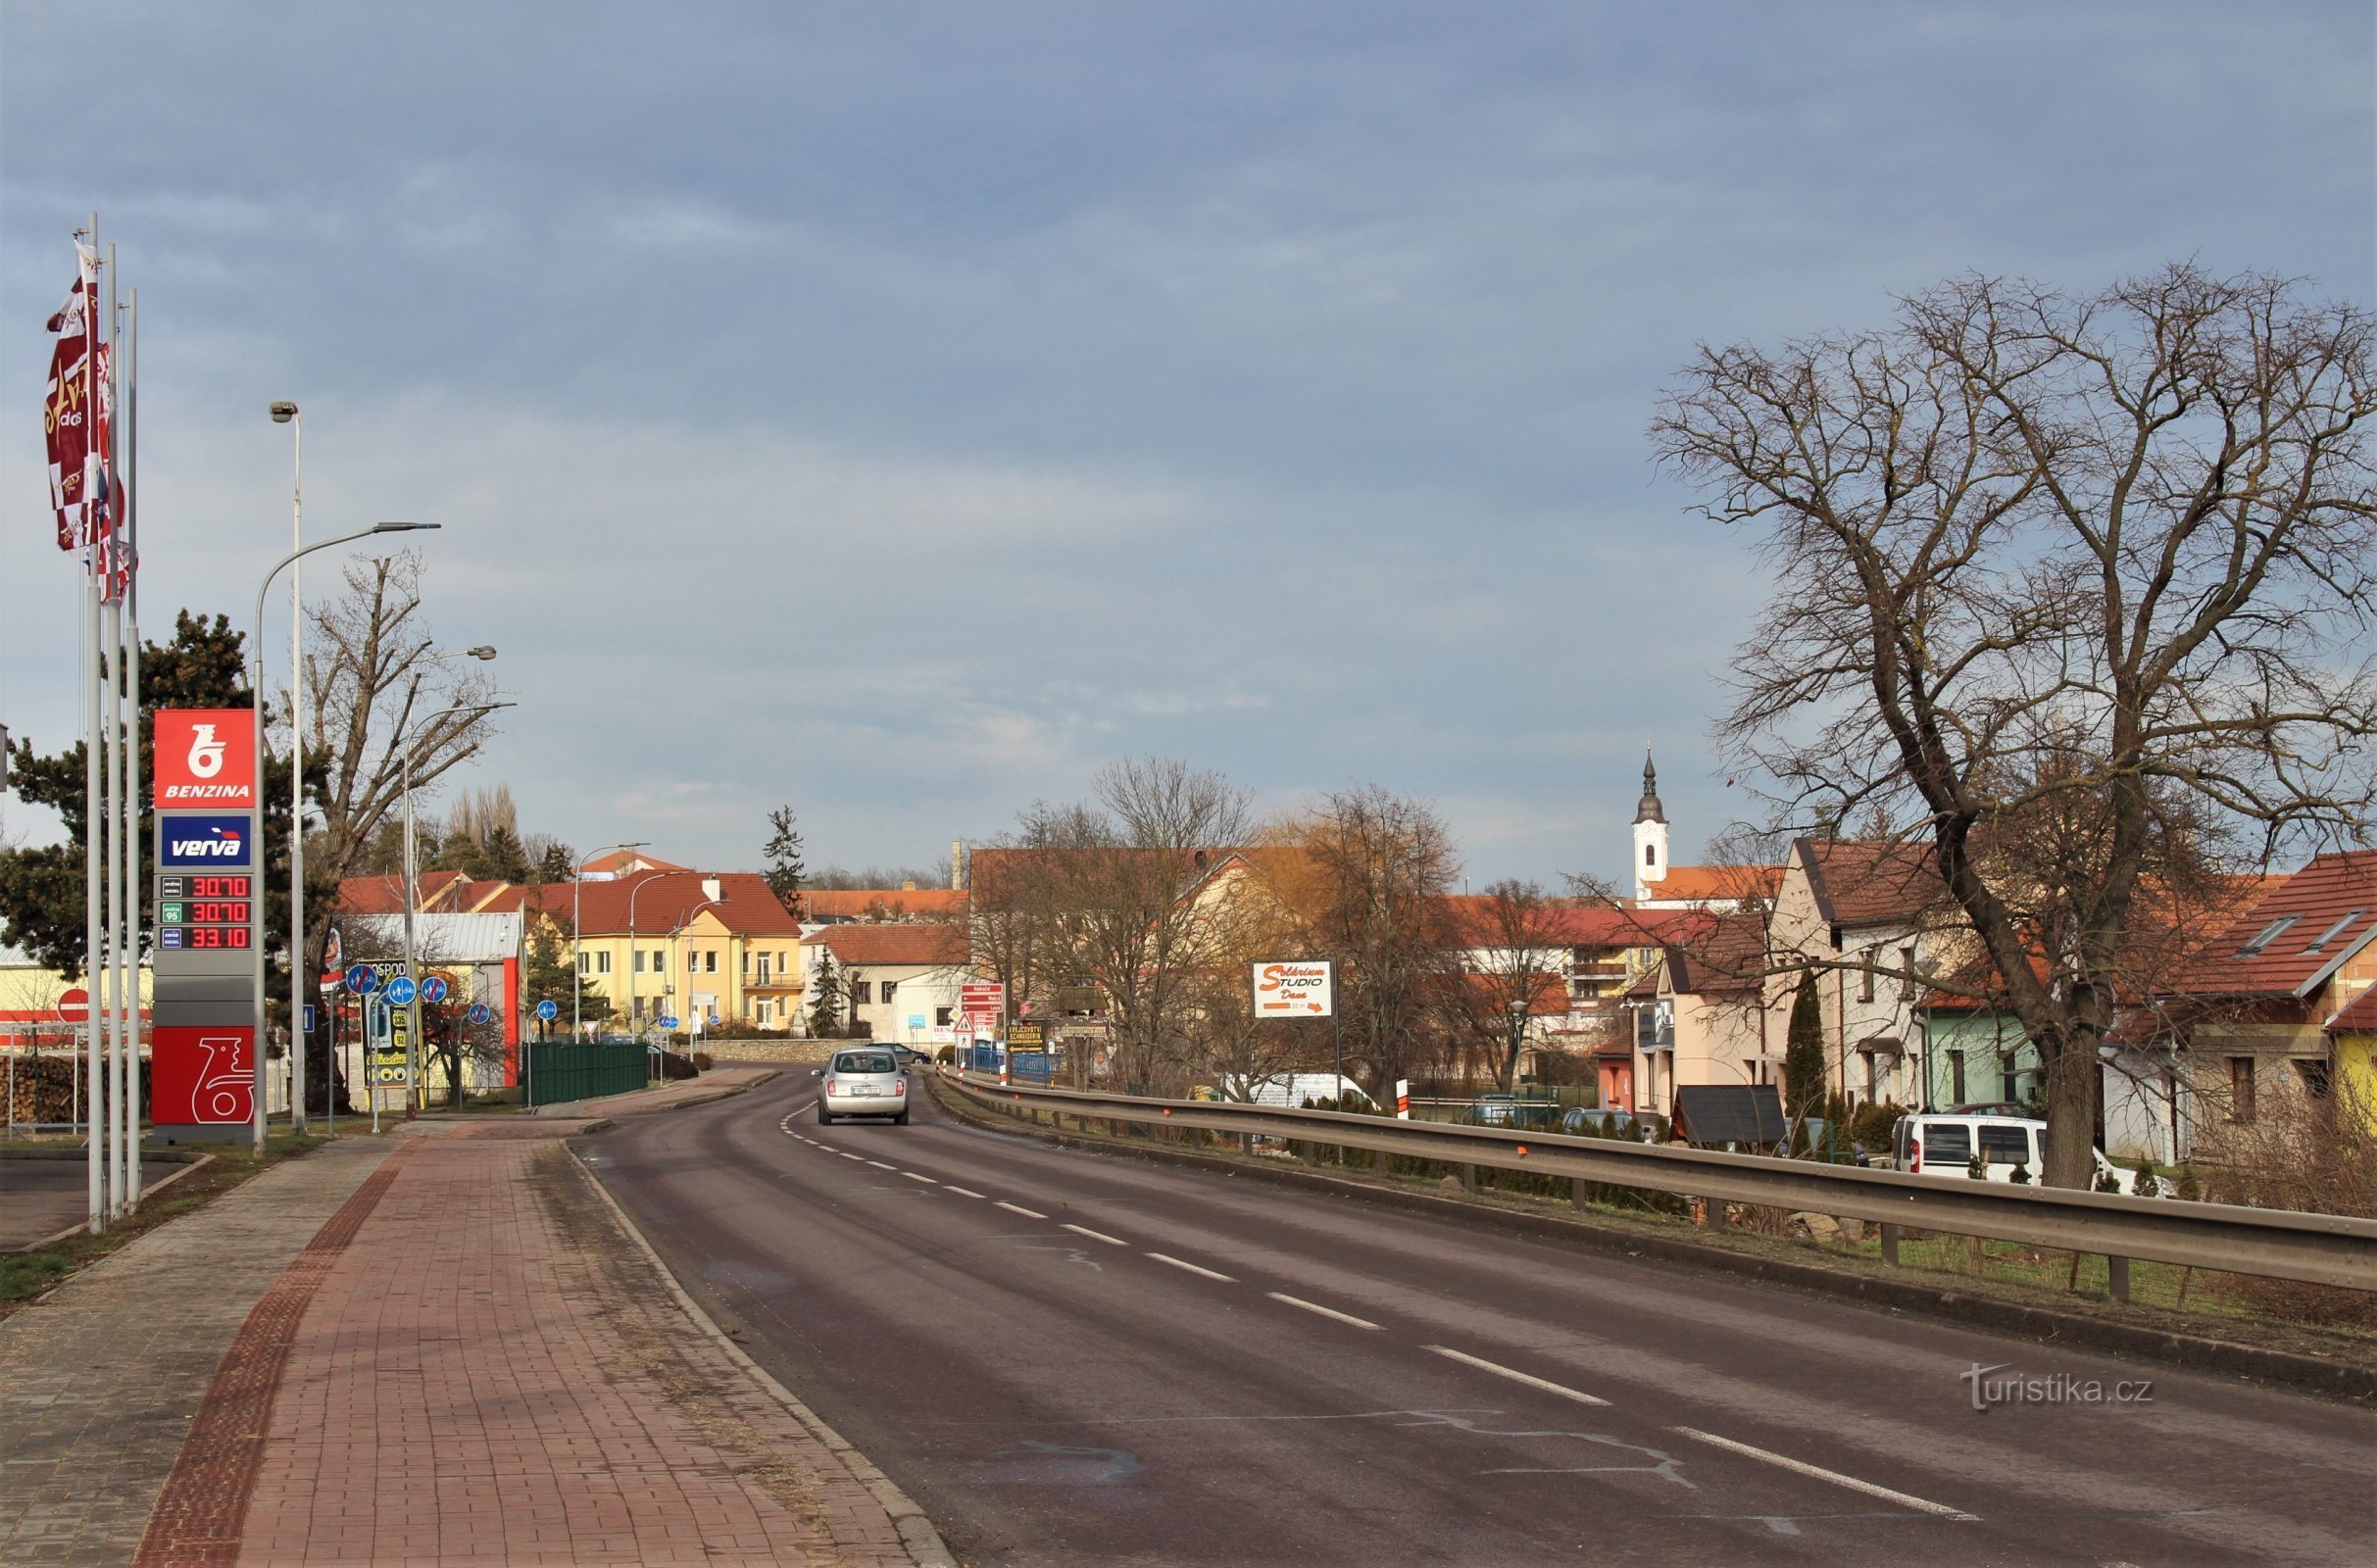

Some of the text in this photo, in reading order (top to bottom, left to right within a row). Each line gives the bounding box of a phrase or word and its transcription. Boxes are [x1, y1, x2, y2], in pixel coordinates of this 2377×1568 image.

[165, 785, 249, 798] BENZINA
[173, 841, 241, 856] verva
[193, 878, 247, 897] 30.70
[166, 912, 178, 921] 95
[193, 904, 247, 921] 30.70
[193, 929, 246, 947] 33.10
